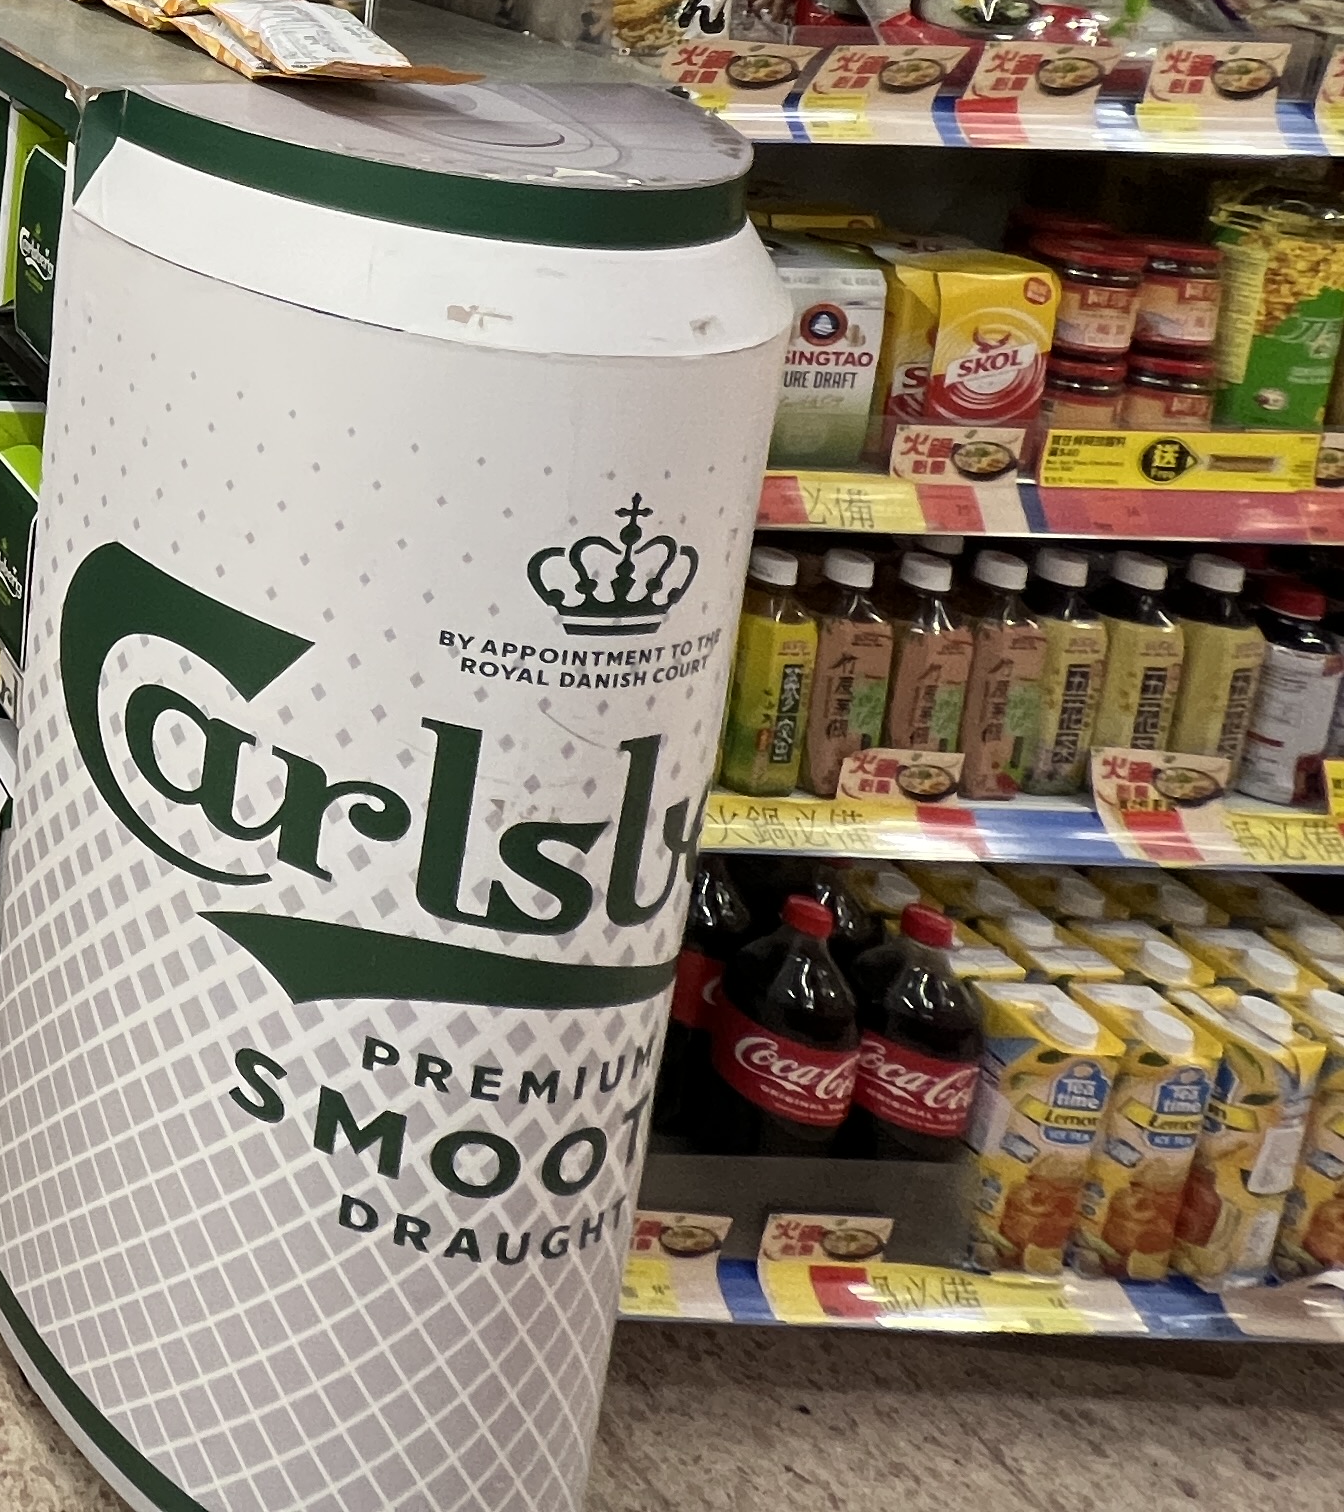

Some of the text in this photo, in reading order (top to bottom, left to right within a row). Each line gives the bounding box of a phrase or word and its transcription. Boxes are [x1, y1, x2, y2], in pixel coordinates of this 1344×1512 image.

[784, 350, 874, 369] SINGTAO
[957, 348, 1024, 377] SKOL
[783, 370, 858, 390] URE DRAFT
[438, 629, 475, 652] BY
[479, 636, 660, 668] APPOINTMENT
[663, 637, 693, 663] TO
[459, 655, 714, 690] ROYAL DANISH COURT
[362, 1034, 662, 1105] PREMIUM
[1056, 1095, 1100, 1109] time
[1044, 1108, 1099, 1127] Lemon
